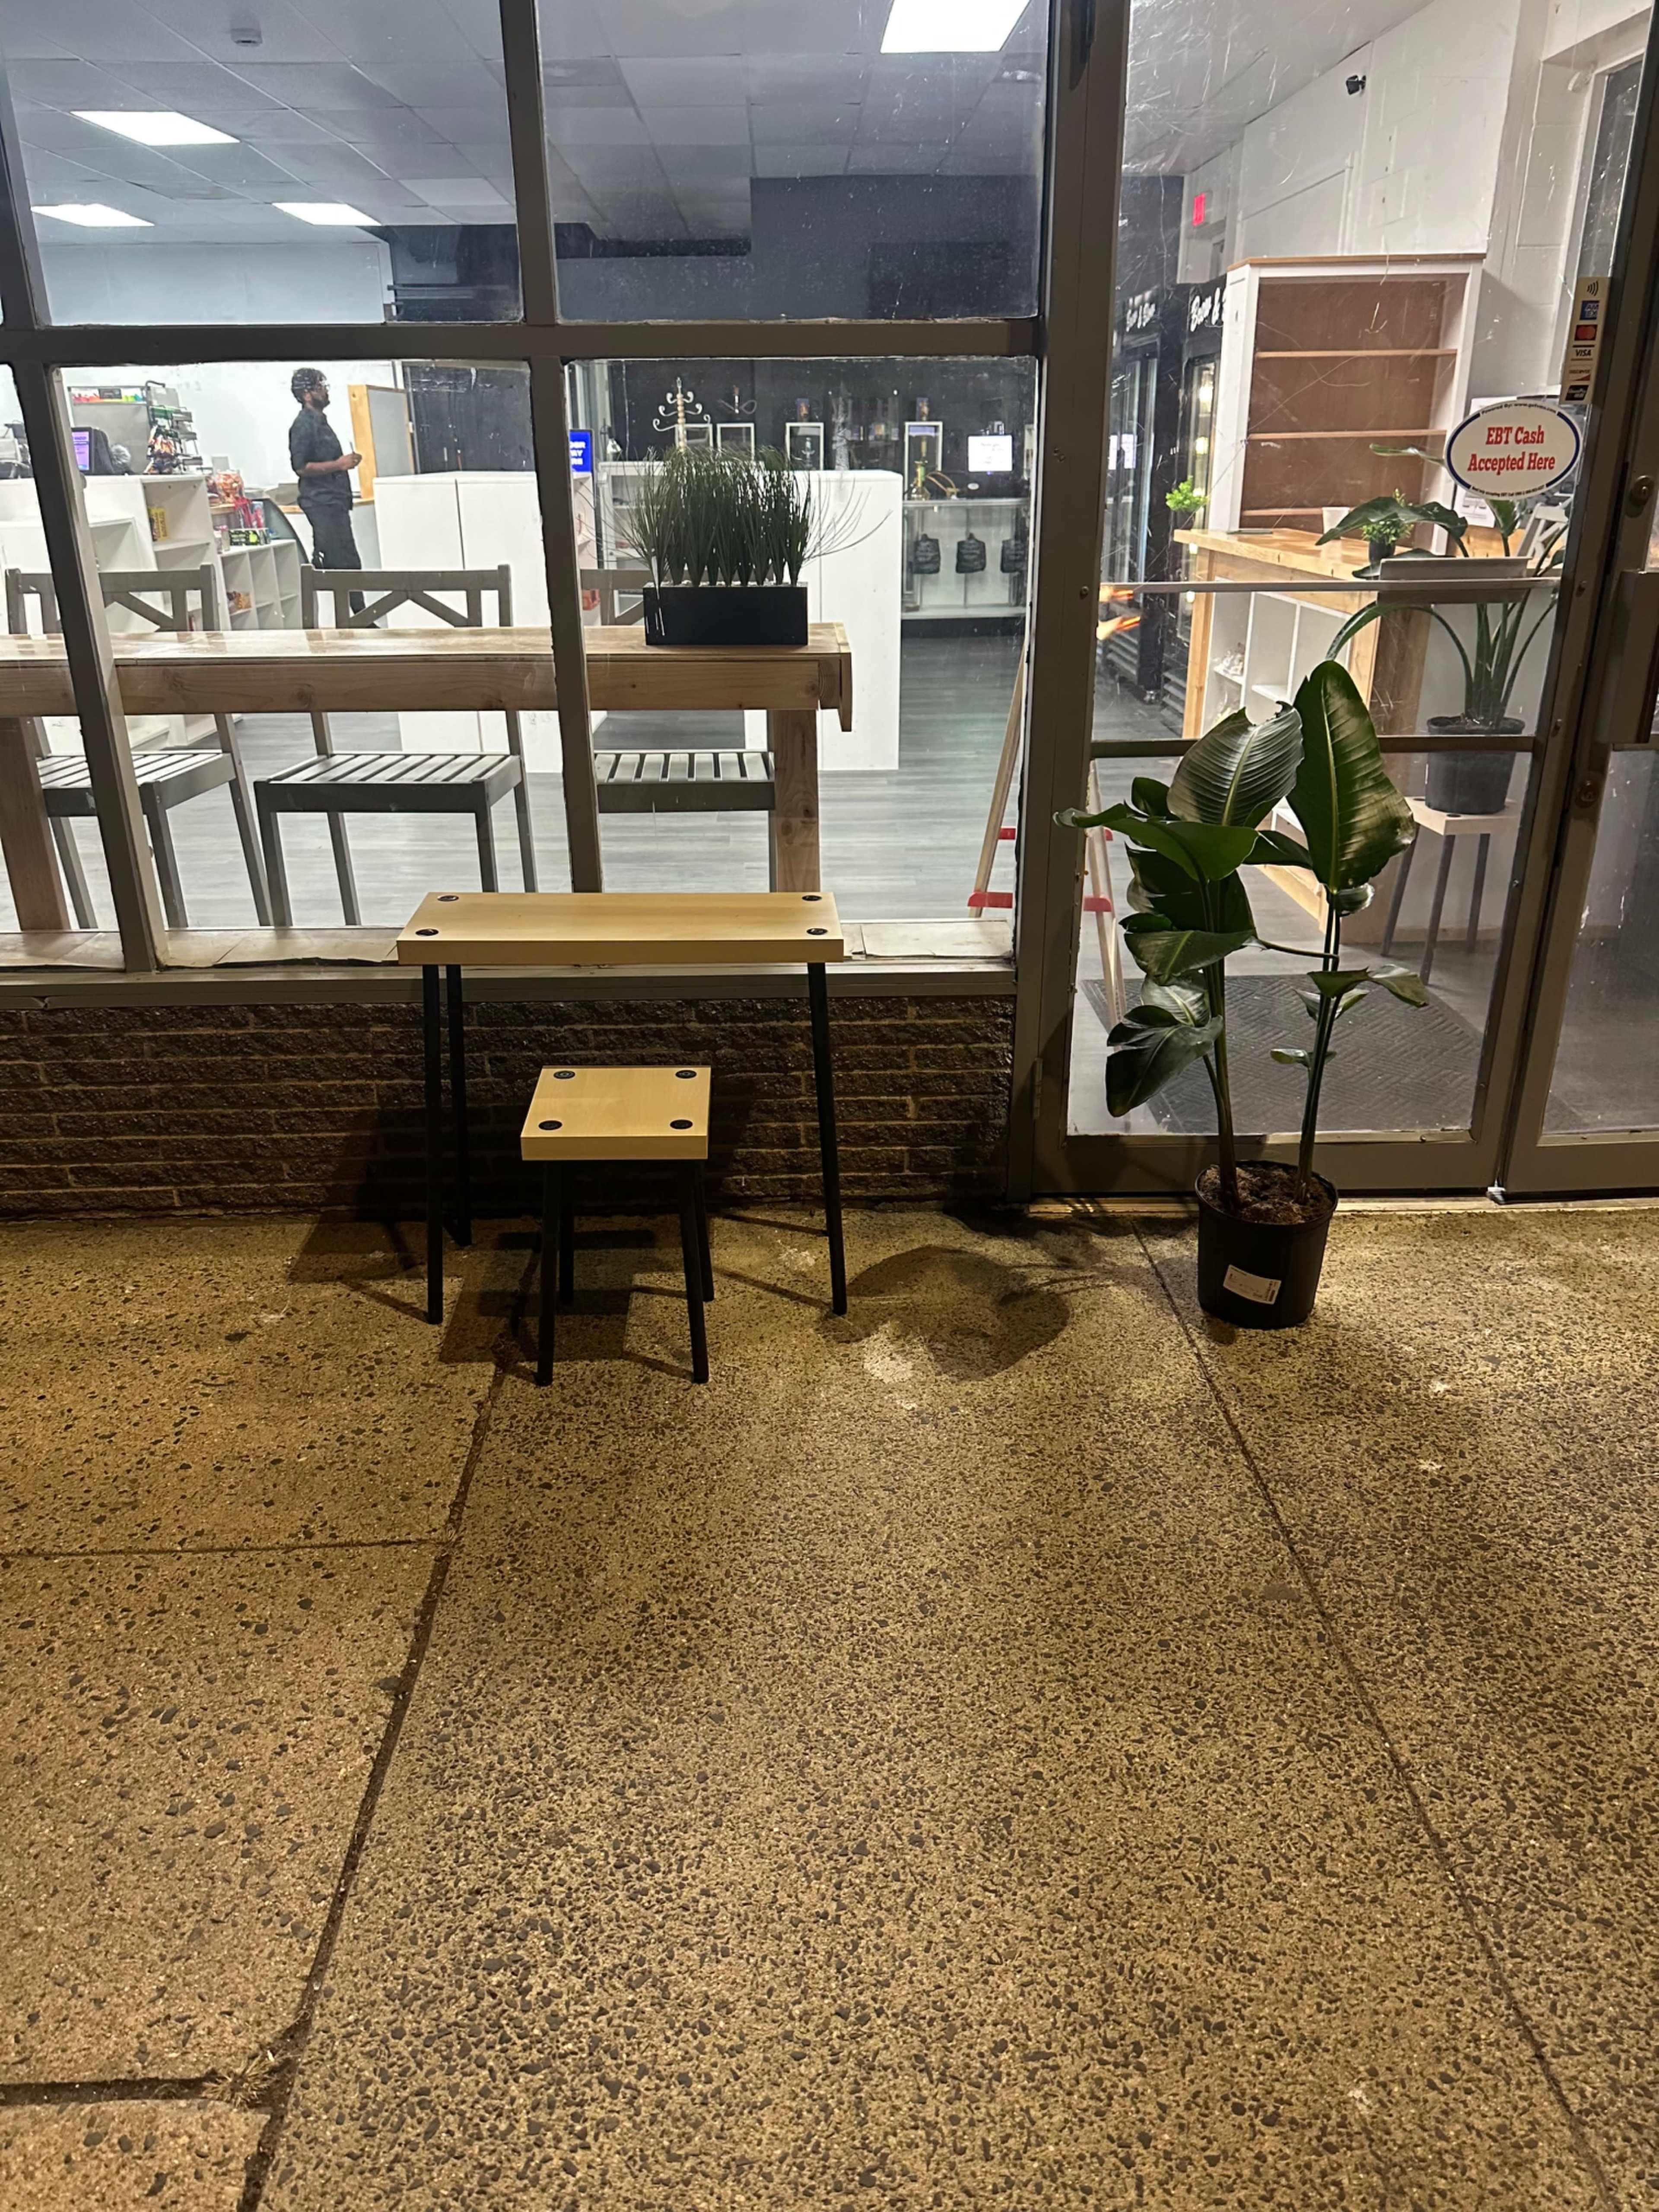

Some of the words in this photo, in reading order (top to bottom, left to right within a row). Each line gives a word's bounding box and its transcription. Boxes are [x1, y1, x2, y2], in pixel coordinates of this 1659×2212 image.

[1485, 427, 1513, 445] EBT
[1514, 425, 1544, 445] Cash
[1467, 451, 1525, 475] Accepted
[1527, 452, 1555, 470] Here
